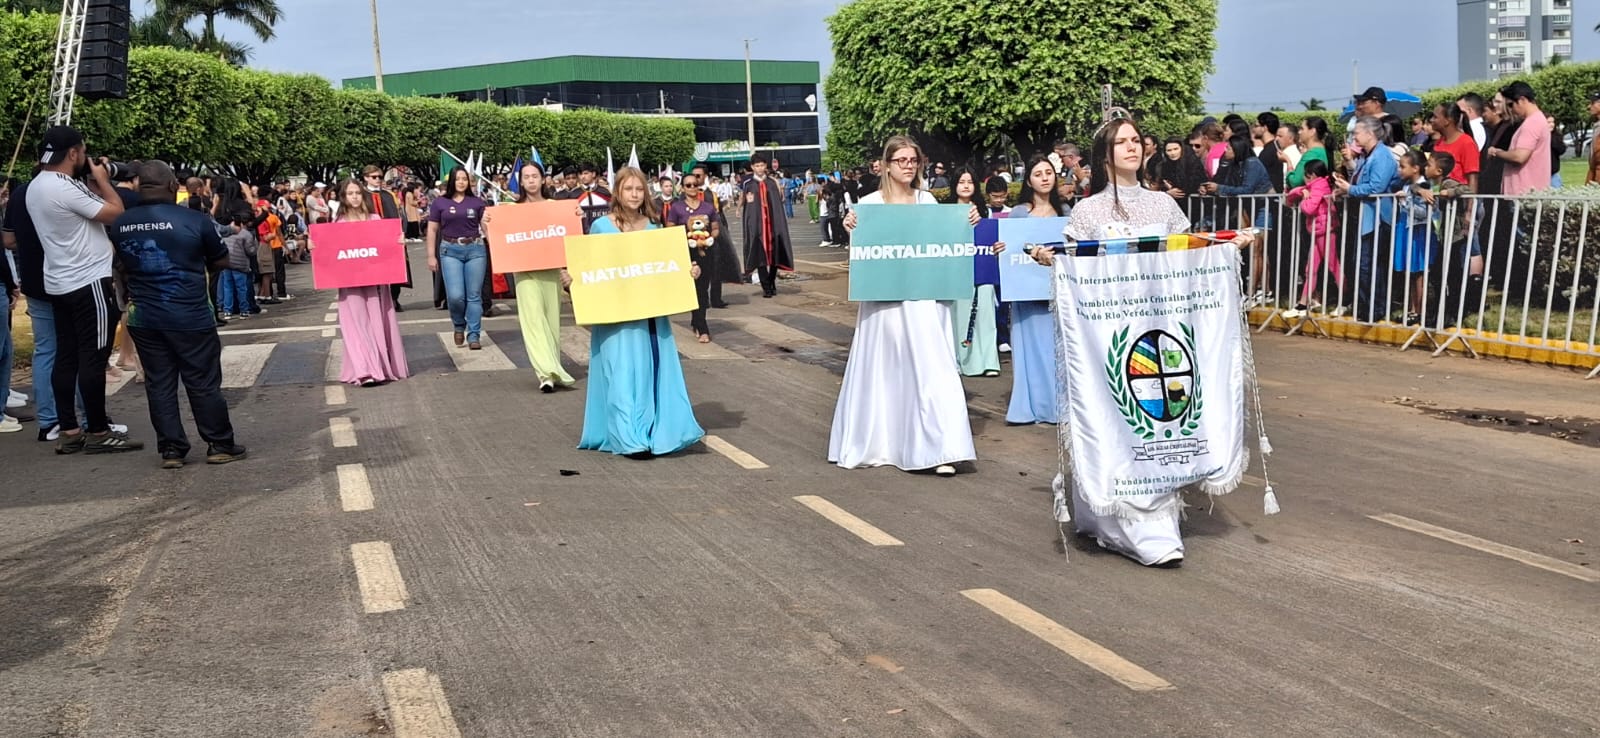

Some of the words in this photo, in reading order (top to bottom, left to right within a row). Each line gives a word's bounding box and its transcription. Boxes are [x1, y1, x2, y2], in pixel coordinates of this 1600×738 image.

[120, 222, 173, 233] IMPRENSA
[505, 224, 567, 244] RELIGIÃO
[337, 247, 379, 260] AMOR
[851, 243, 975, 260] IMORTALIDADE
[581, 260, 680, 284] NATUREZA
[1080, 273, 1139, 285] Internacional
[1204, 289, 1215, 297] de
[1105, 312, 1121, 320] Rio
[1114, 476, 1152, 486] Fundada
